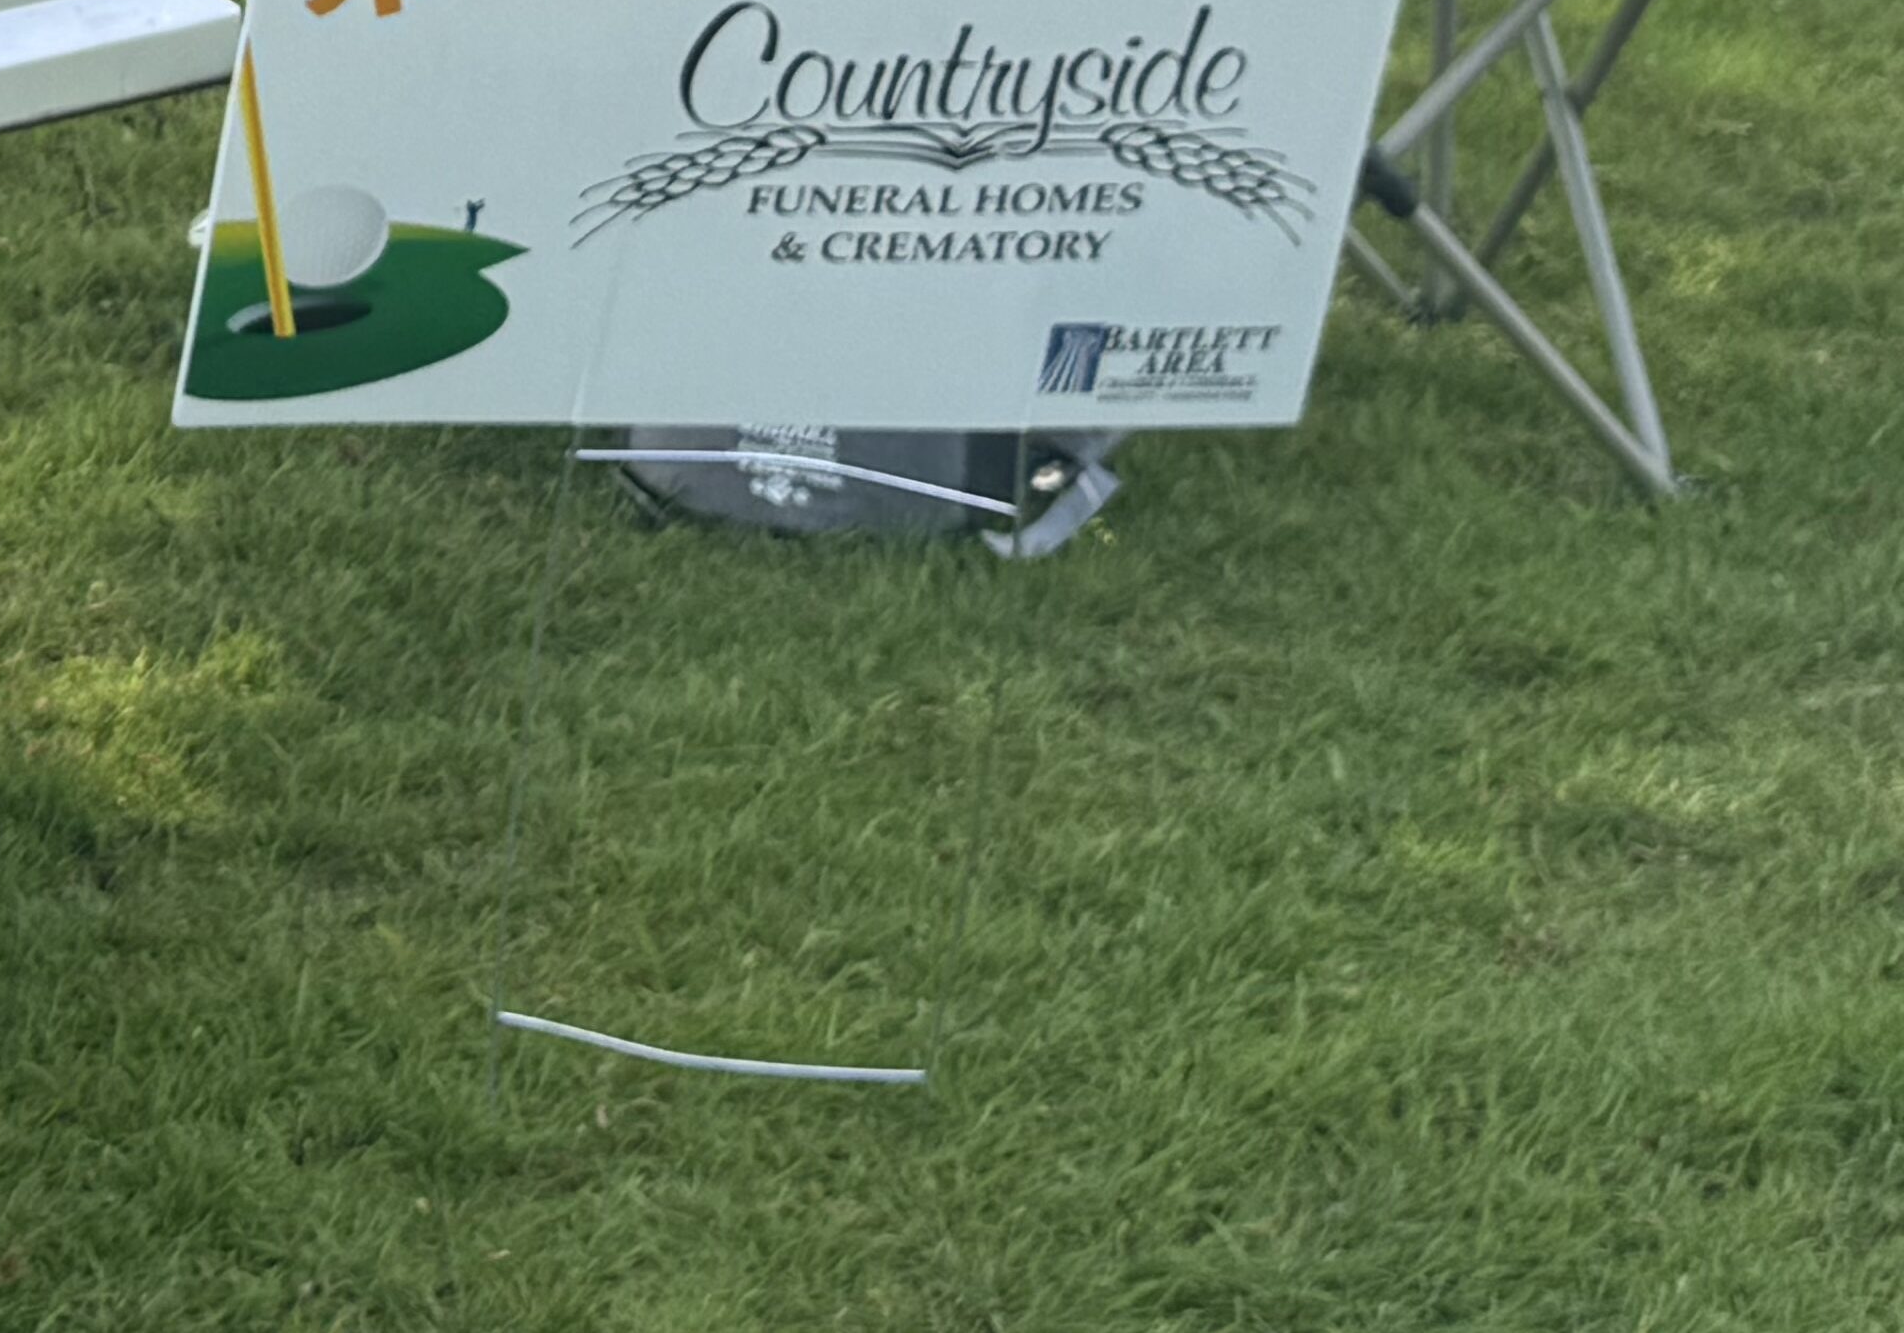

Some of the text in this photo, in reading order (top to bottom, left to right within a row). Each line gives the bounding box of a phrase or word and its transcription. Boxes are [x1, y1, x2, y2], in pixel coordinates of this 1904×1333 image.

[678, 0, 1248, 154] Countryside
[747, 182, 1144, 214] FUNERAL HOMES
[771, 230, 1113, 263] & CREMATORY
[1104, 325, 1281, 352] BARTLETT
[1138, 347, 1225, 375] AREA
